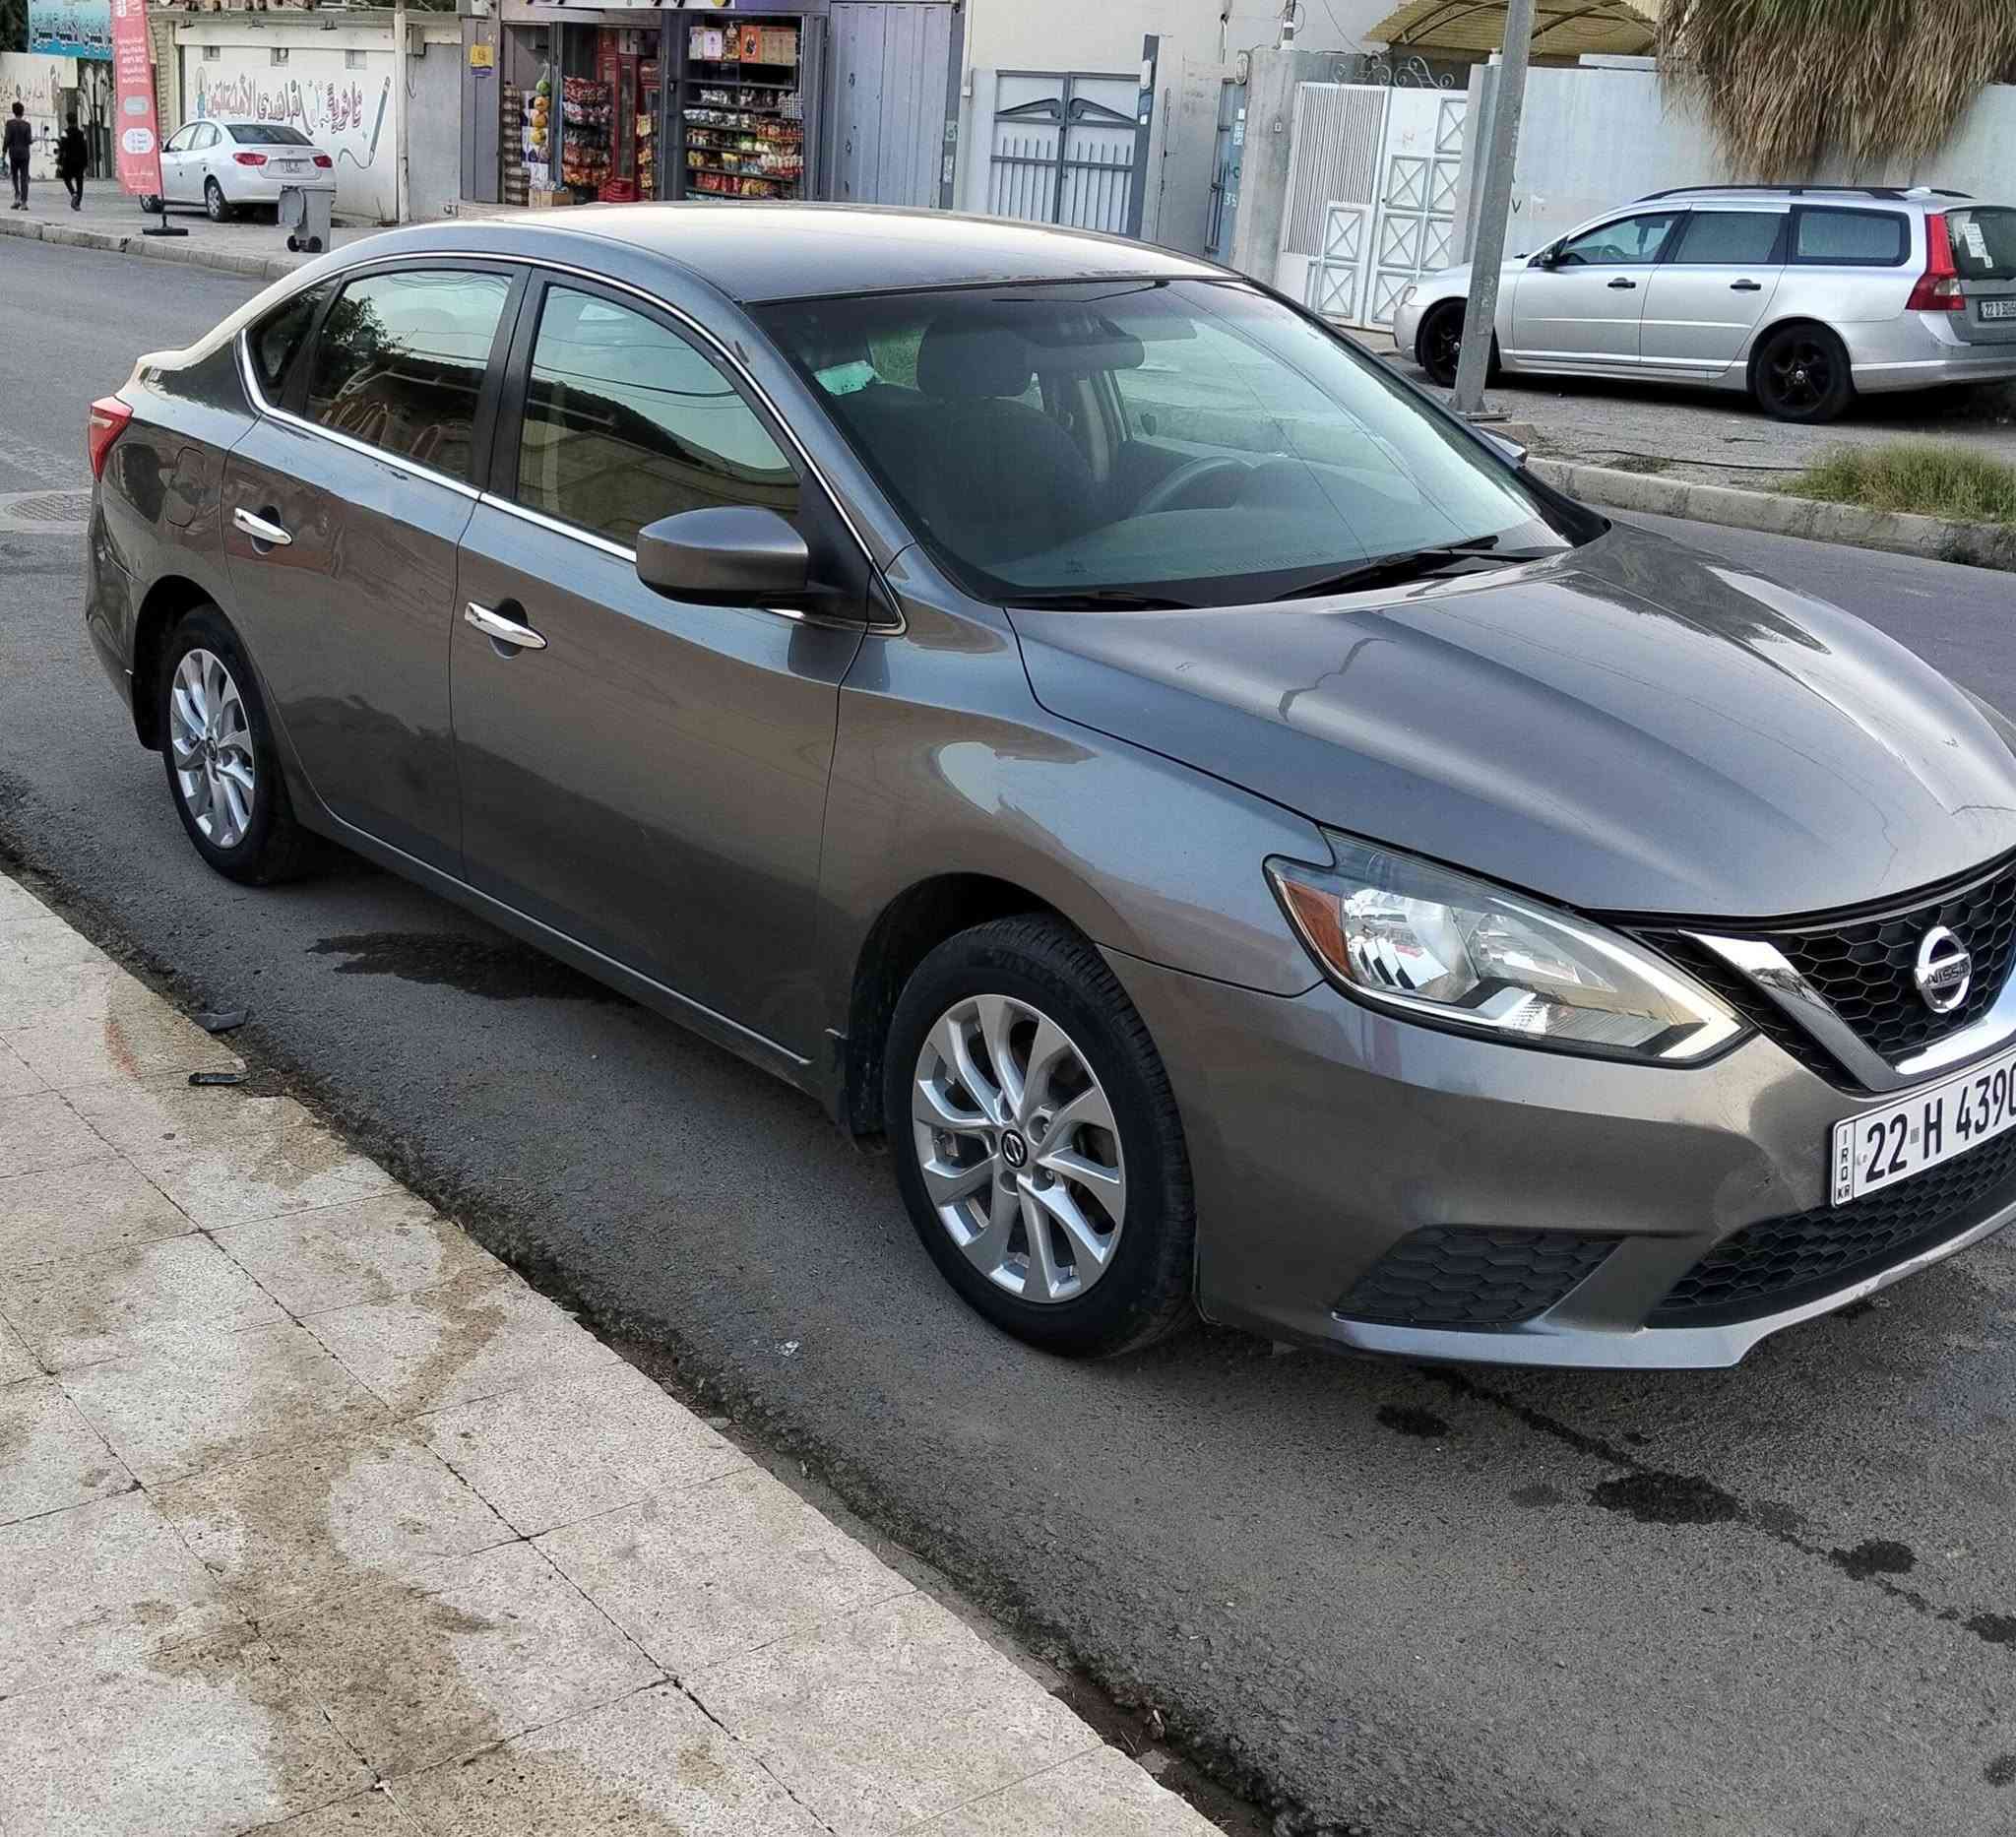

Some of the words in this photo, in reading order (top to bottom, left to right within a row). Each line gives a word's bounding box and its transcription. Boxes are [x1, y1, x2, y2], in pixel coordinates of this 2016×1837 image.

[1865, 1112, 1908, 1183] 22
[1922, 1097, 1943, 1160] H
[1836, 1183, 1851, 1201] KR
